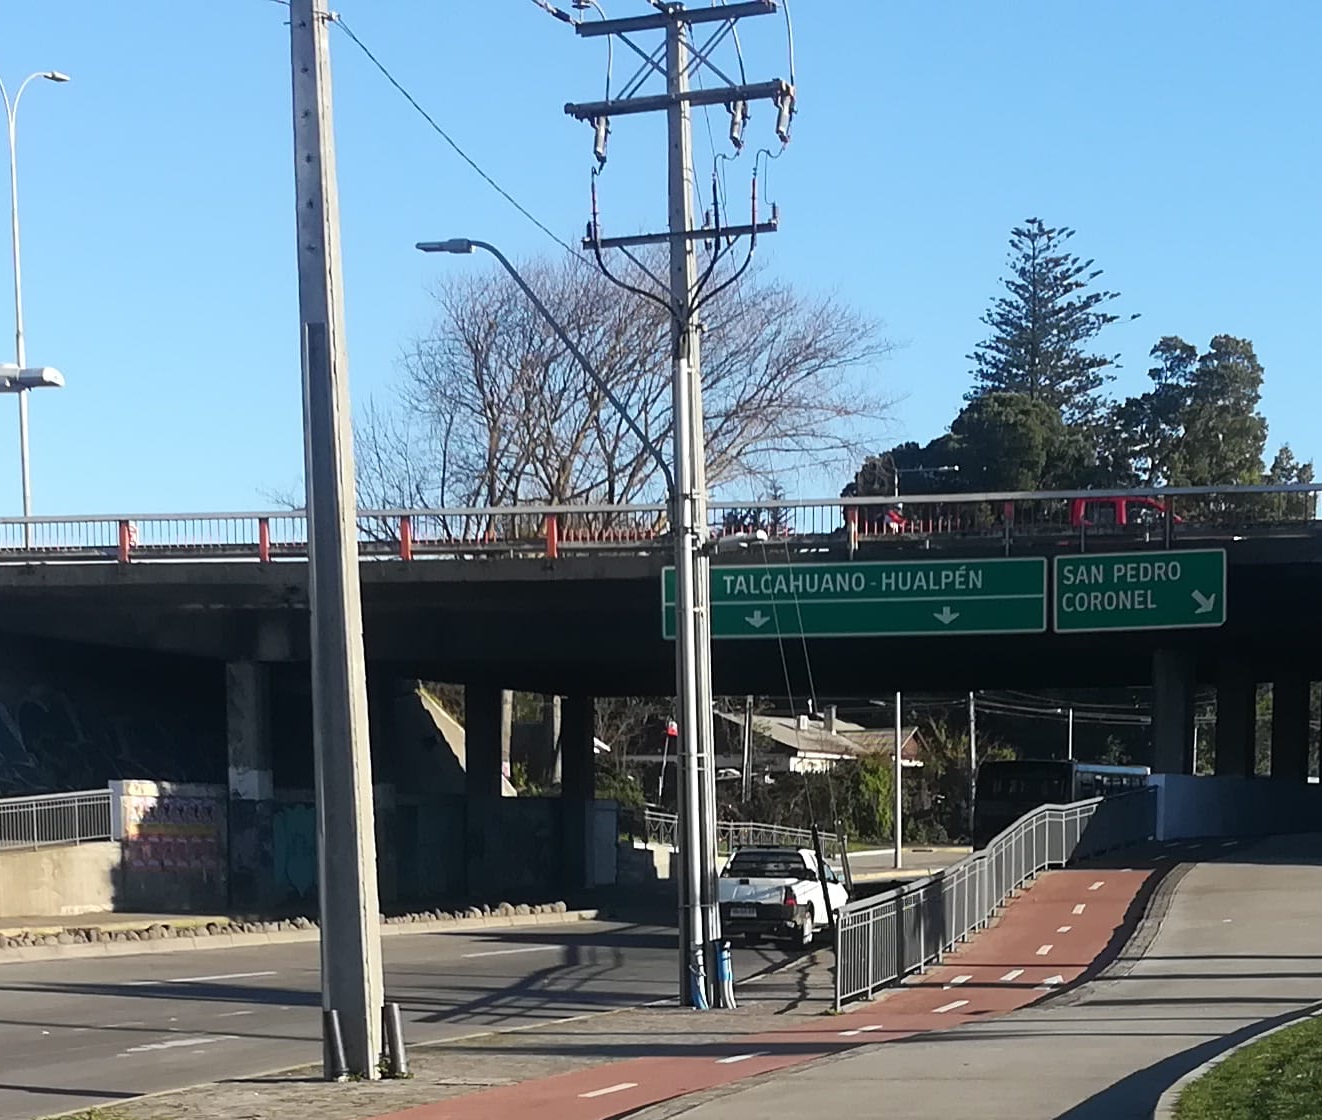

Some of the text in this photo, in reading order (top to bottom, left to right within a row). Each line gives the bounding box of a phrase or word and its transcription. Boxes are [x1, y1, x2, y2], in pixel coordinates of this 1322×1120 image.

[722, 571, 866, 595] TALCAHUANO
[881, 564, 984, 593] HUALPÉN
[1062, 560, 1182, 586] SAN PEDRO
[1061, 588, 1157, 612] CORONEL
